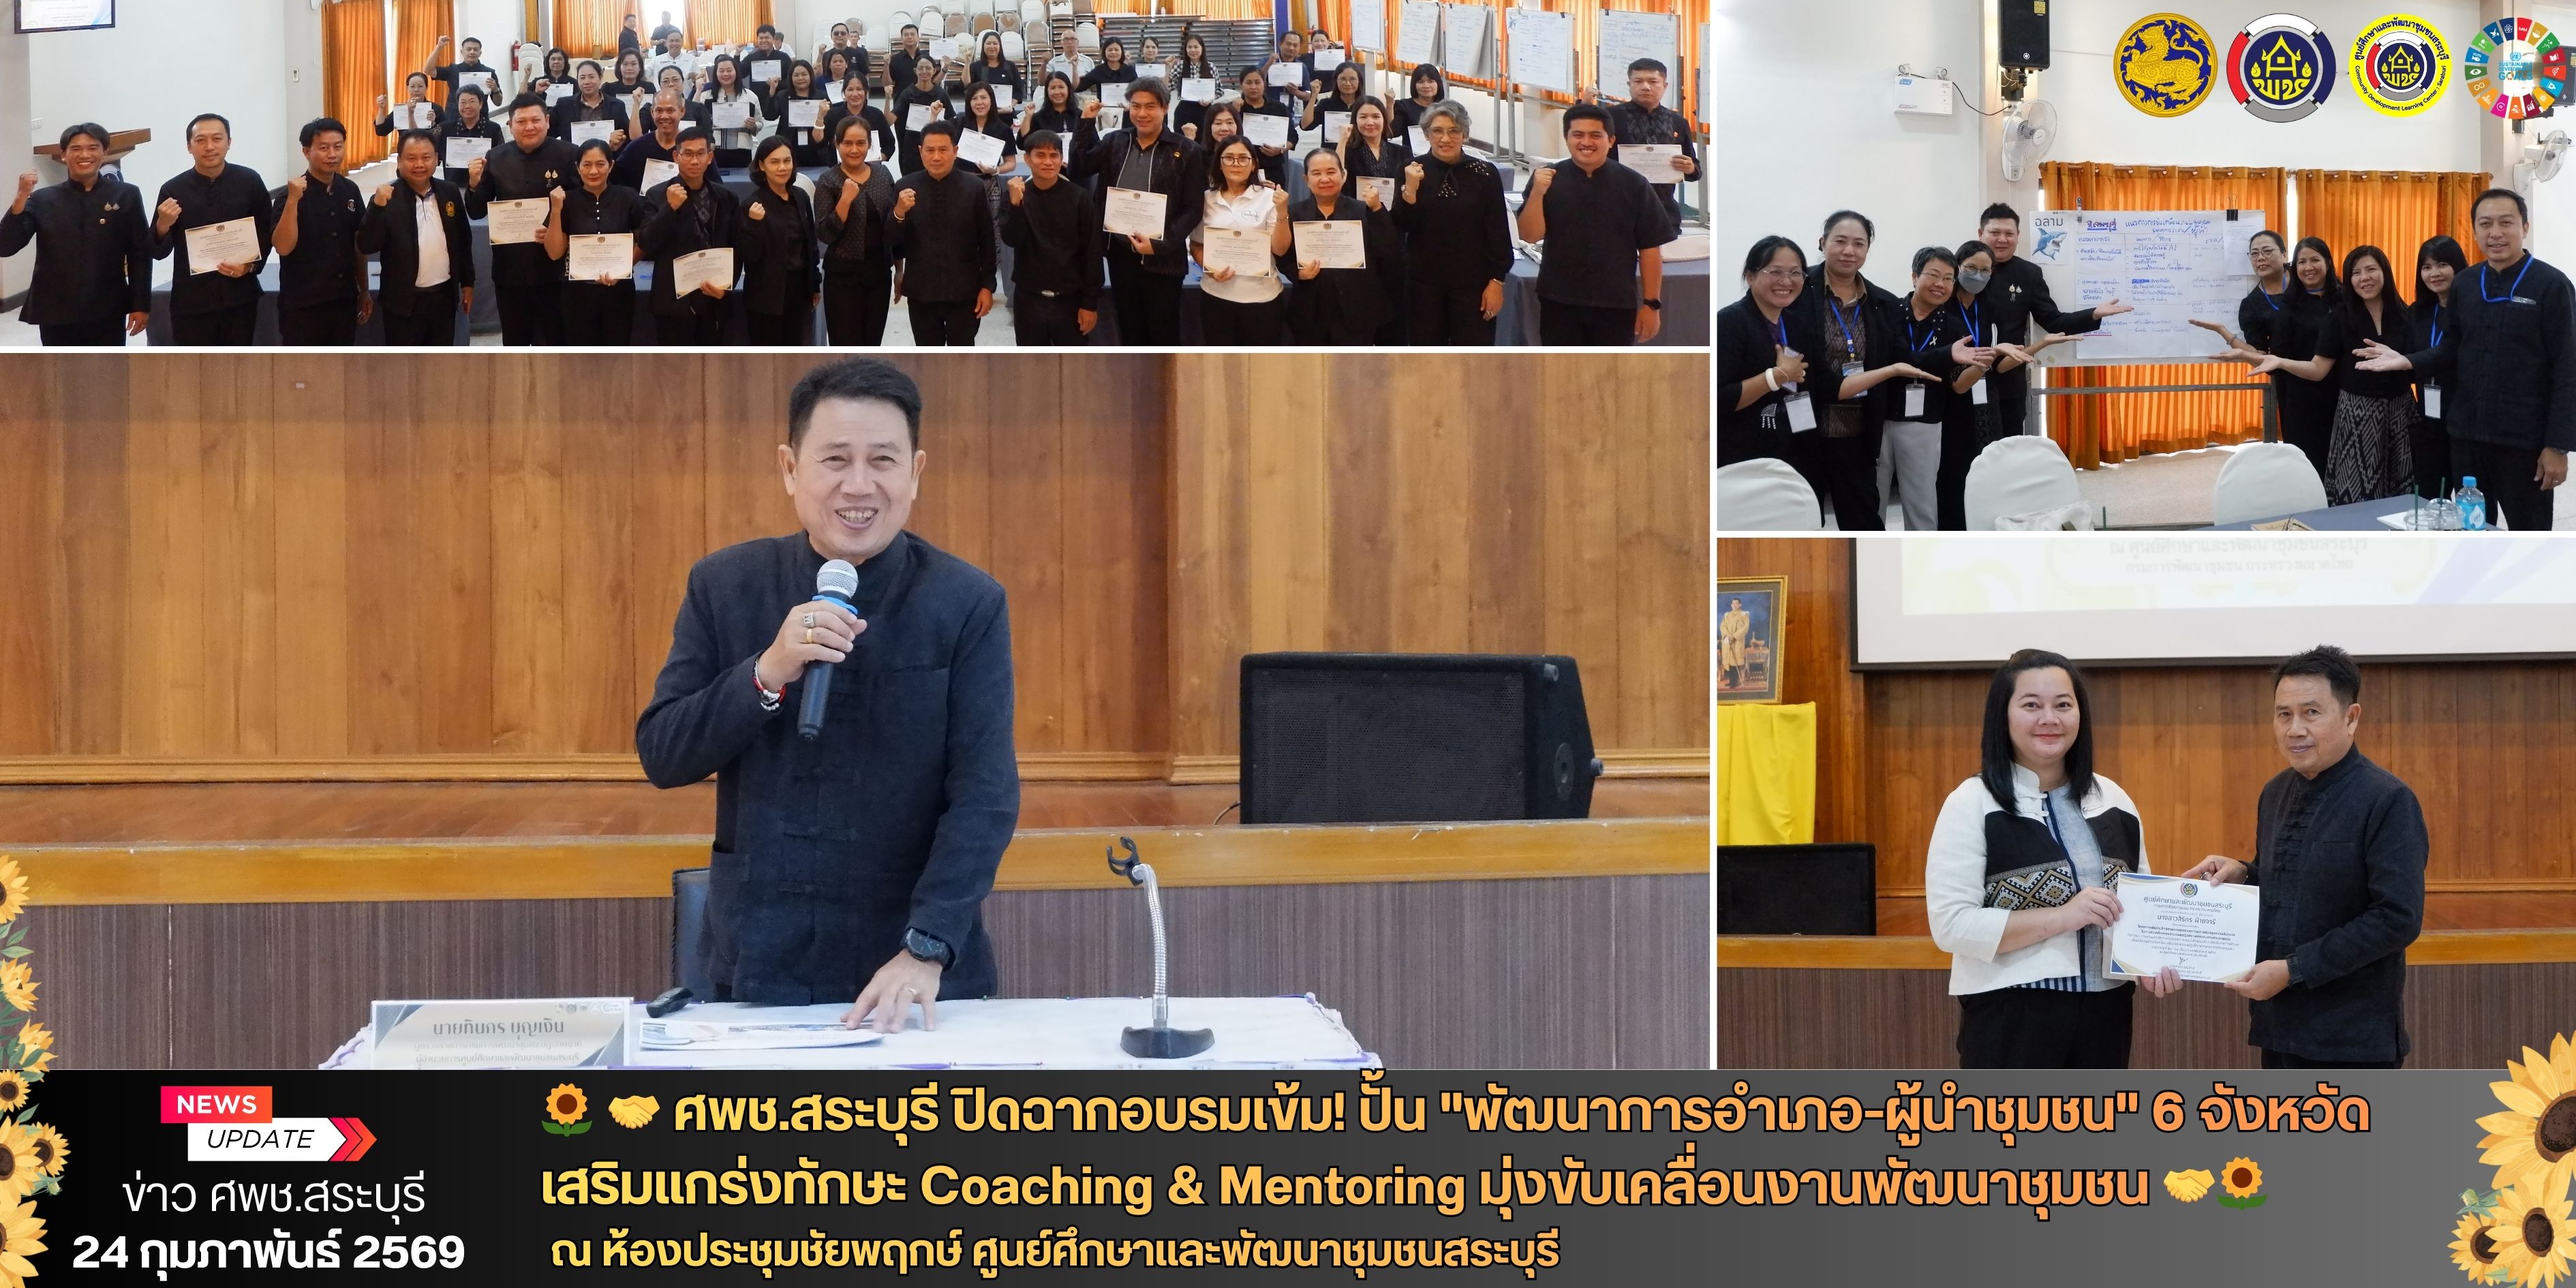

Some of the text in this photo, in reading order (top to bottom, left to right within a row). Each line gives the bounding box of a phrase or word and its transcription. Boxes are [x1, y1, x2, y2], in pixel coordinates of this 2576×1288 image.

[2035, 217, 2064, 226] ฉลาม
[433, 1017, 564, 1040] นายทินกร บุญเงิน
